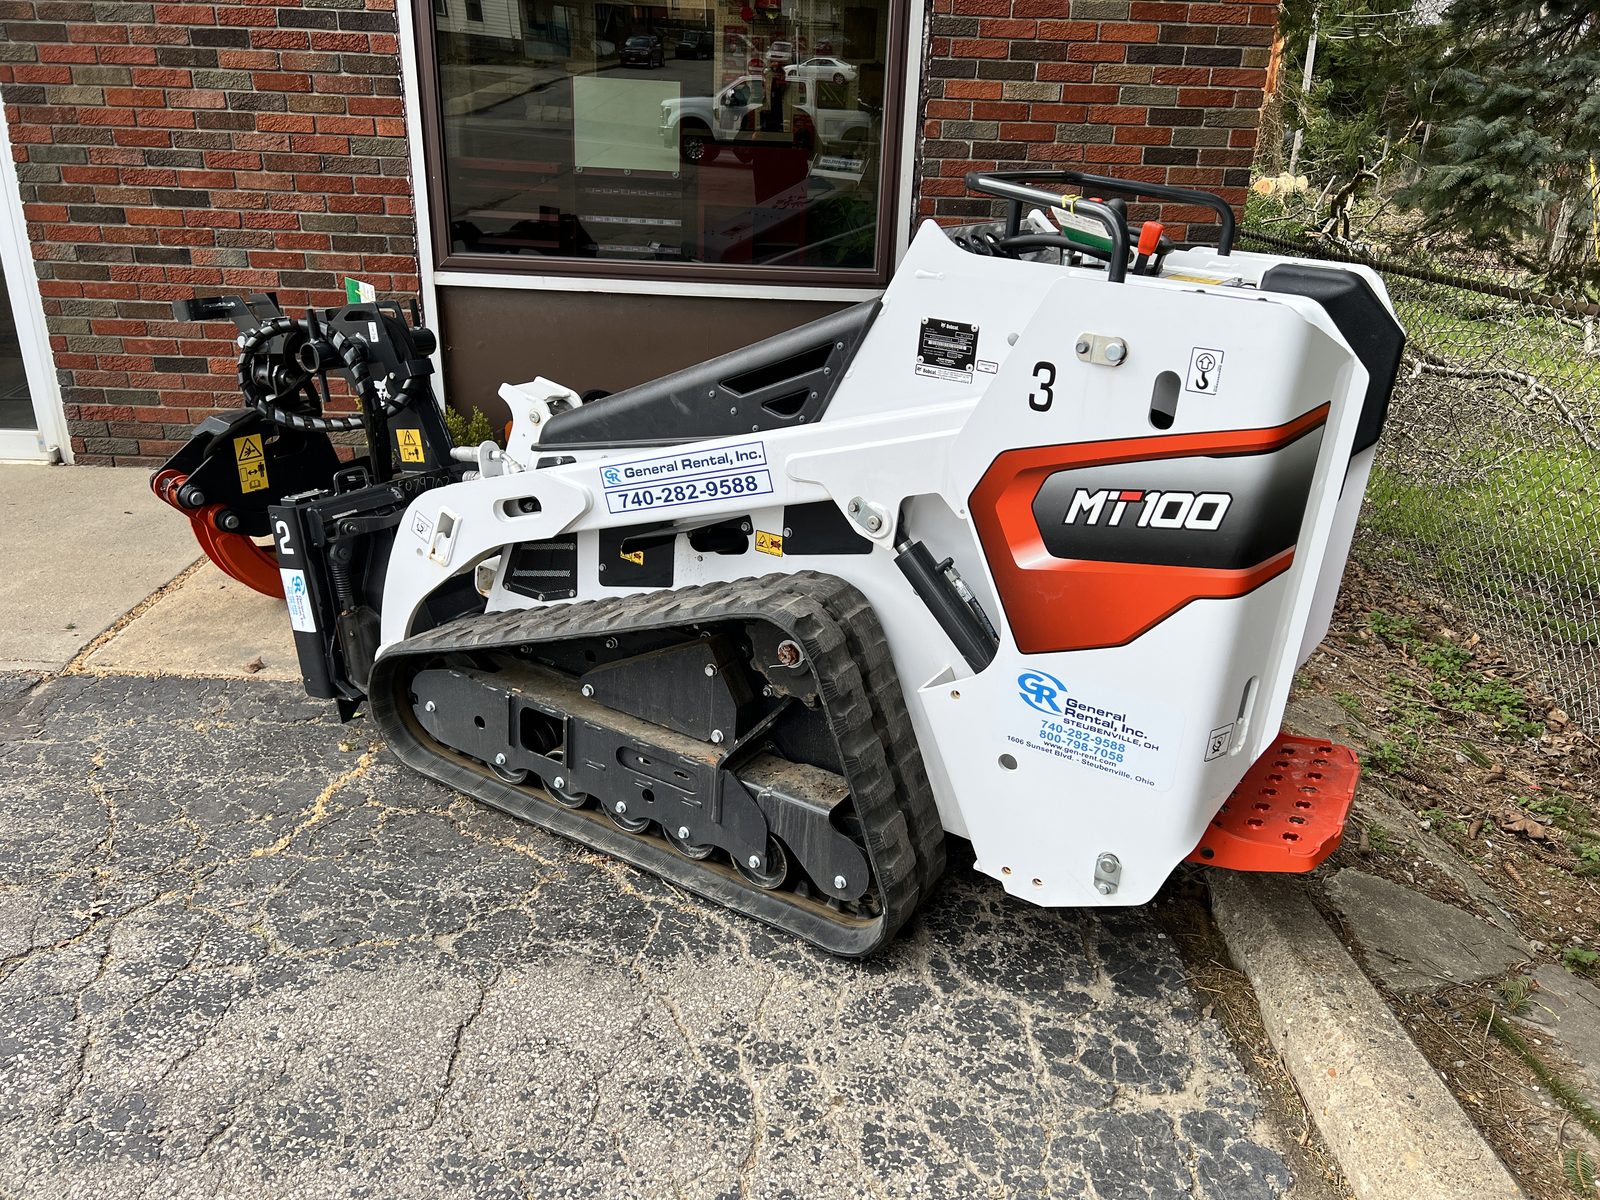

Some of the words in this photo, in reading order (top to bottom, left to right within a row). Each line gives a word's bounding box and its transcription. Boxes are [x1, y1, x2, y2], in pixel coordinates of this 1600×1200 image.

[1028, 361, 1057, 412] 3
[624, 461, 678, 479] General
[681, 453, 733, 470] Rental,
[736, 449, 762, 462] Inc.
[618, 475, 758, 509] 740-282-9588
[1062, 488, 1233, 531] MT100
[275, 520, 295, 555] 2
[1064, 707, 1118, 732] Rental,
[1121, 724, 1148, 739] Inc.
[1066, 698, 1126, 722] General
[1039, 730, 1124, 763] 800-798-7058
[1040, 719, 1126, 753] 740-282-9588
[1063, 718, 1142, 747] STEUBENVILLE,
[1143, 742, 1160, 751] OH
[1007, 735, 1025, 745] 1606
[1026, 741, 1053, 755] Sunset
[1054, 750, 1074, 761] Blvd.
[1081, 758, 1133, 780] Steubenville,
[1135, 775, 1155, 786] Ohio
[1043, 741, 1117, 768] www.gen-rent.com
